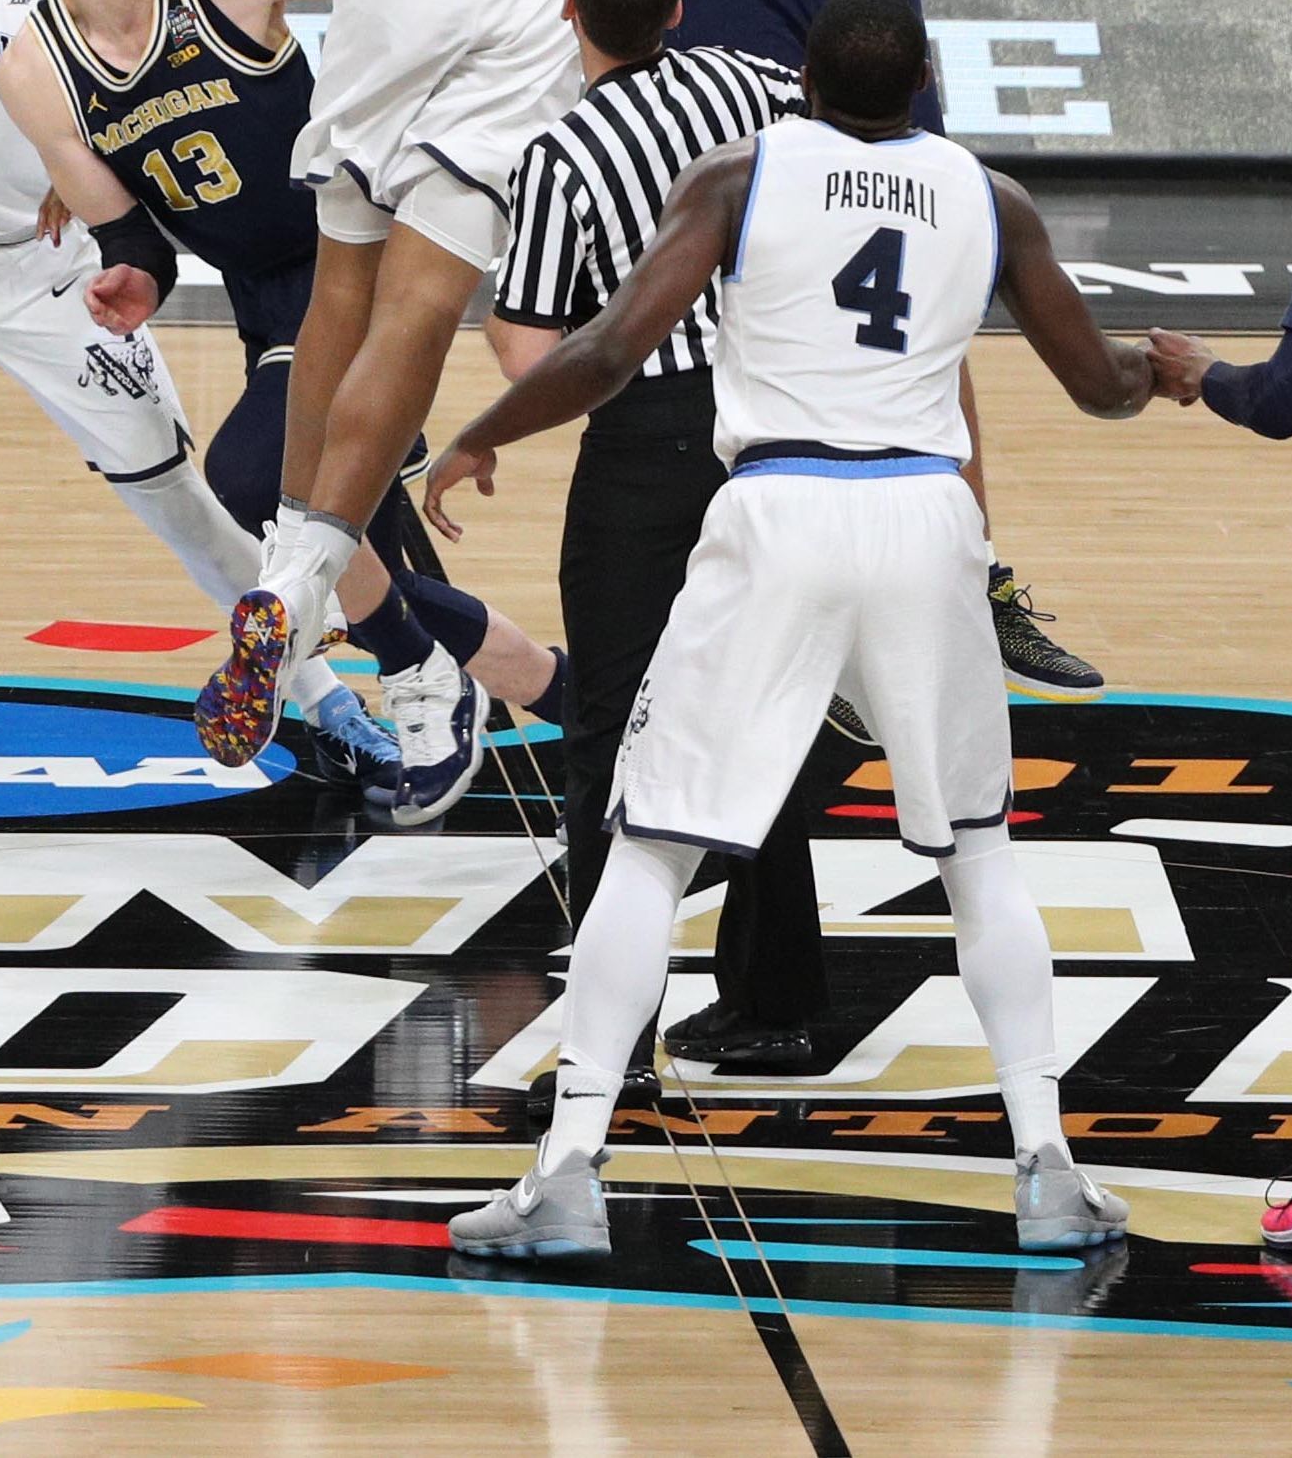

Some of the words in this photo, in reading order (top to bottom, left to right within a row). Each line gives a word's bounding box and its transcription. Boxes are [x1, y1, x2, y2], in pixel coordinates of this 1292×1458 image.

[141, 130, 243, 211] 13
[825, 170, 938, 230] PASCHALL
[831, 227, 912, 355] 4
